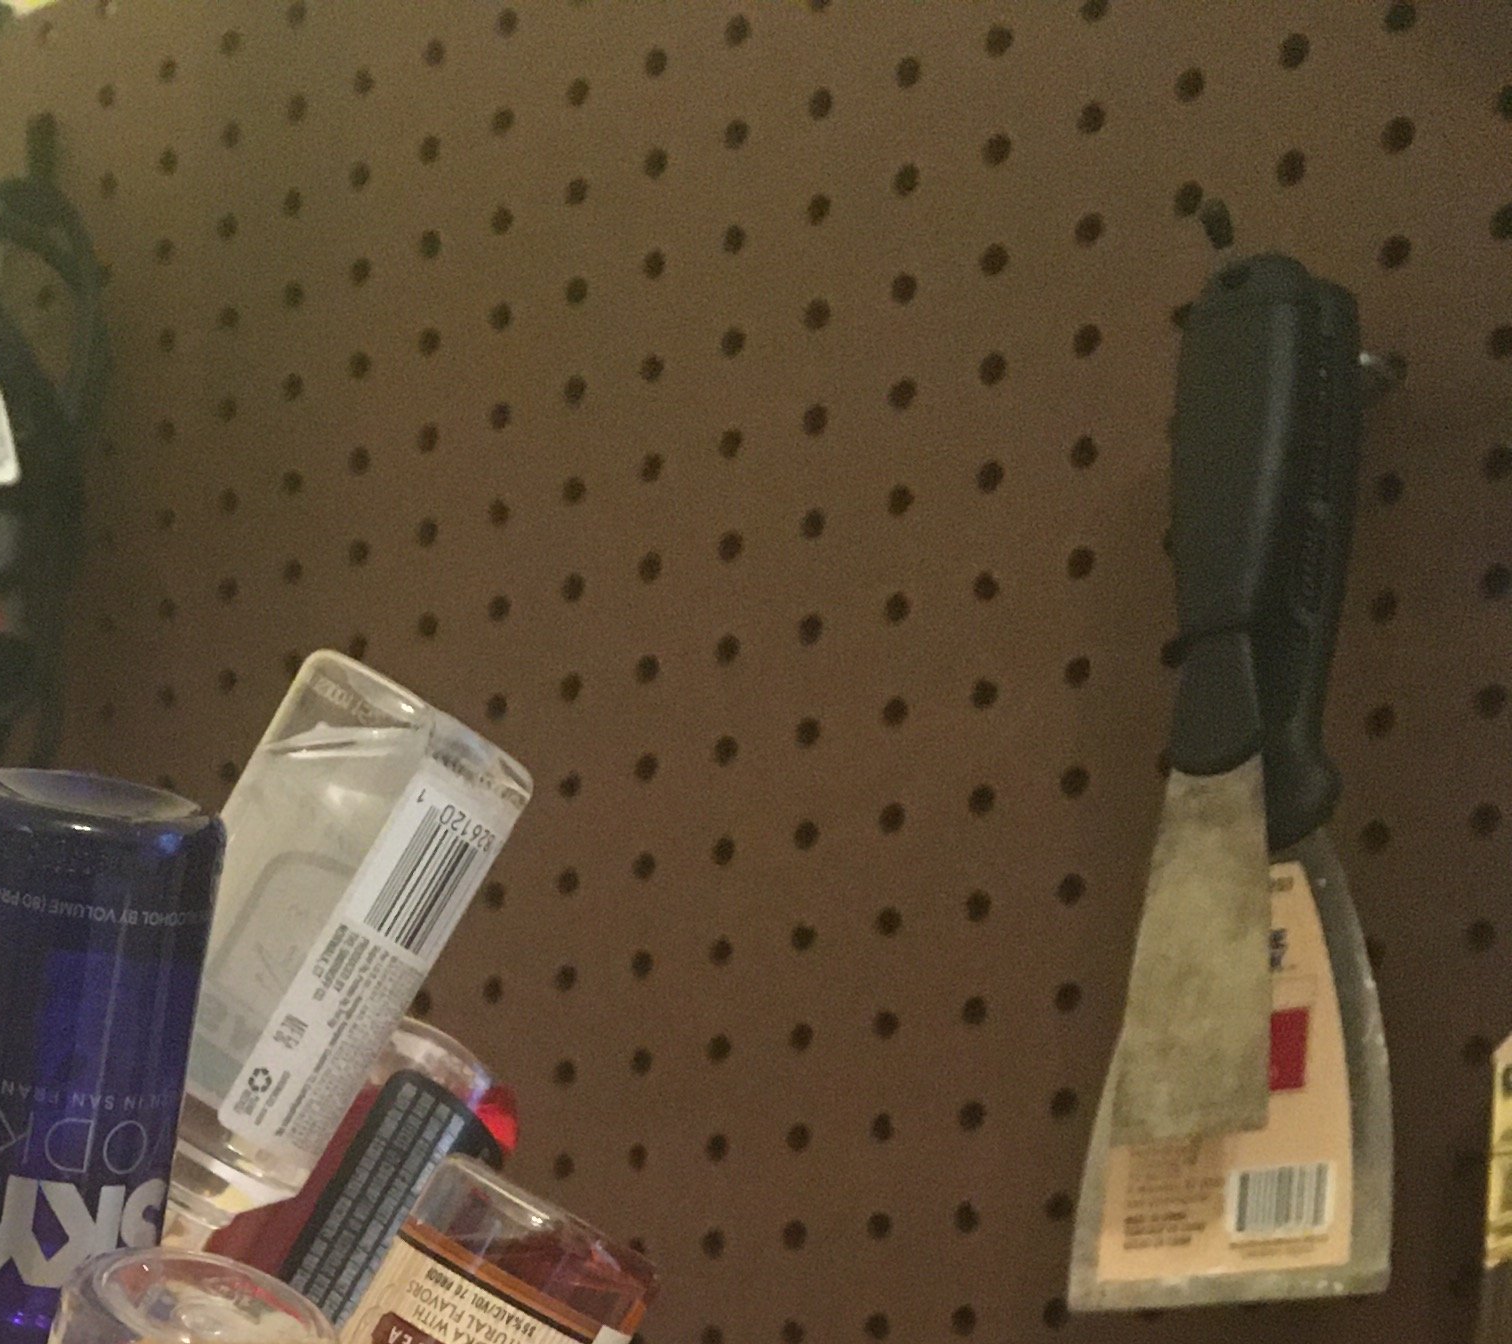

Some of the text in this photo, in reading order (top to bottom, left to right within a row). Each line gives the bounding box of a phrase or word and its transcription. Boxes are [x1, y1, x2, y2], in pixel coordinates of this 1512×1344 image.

[47, 898, 117, 922] VOLUME
[119, 909, 138, 926] BY
[141, 909, 197, 928] COHOL
[72, 1091, 115, 1111] SAN
[405, 1280, 465, 1323] FLAVORS
[412, 1304, 449, 1337] WITH
